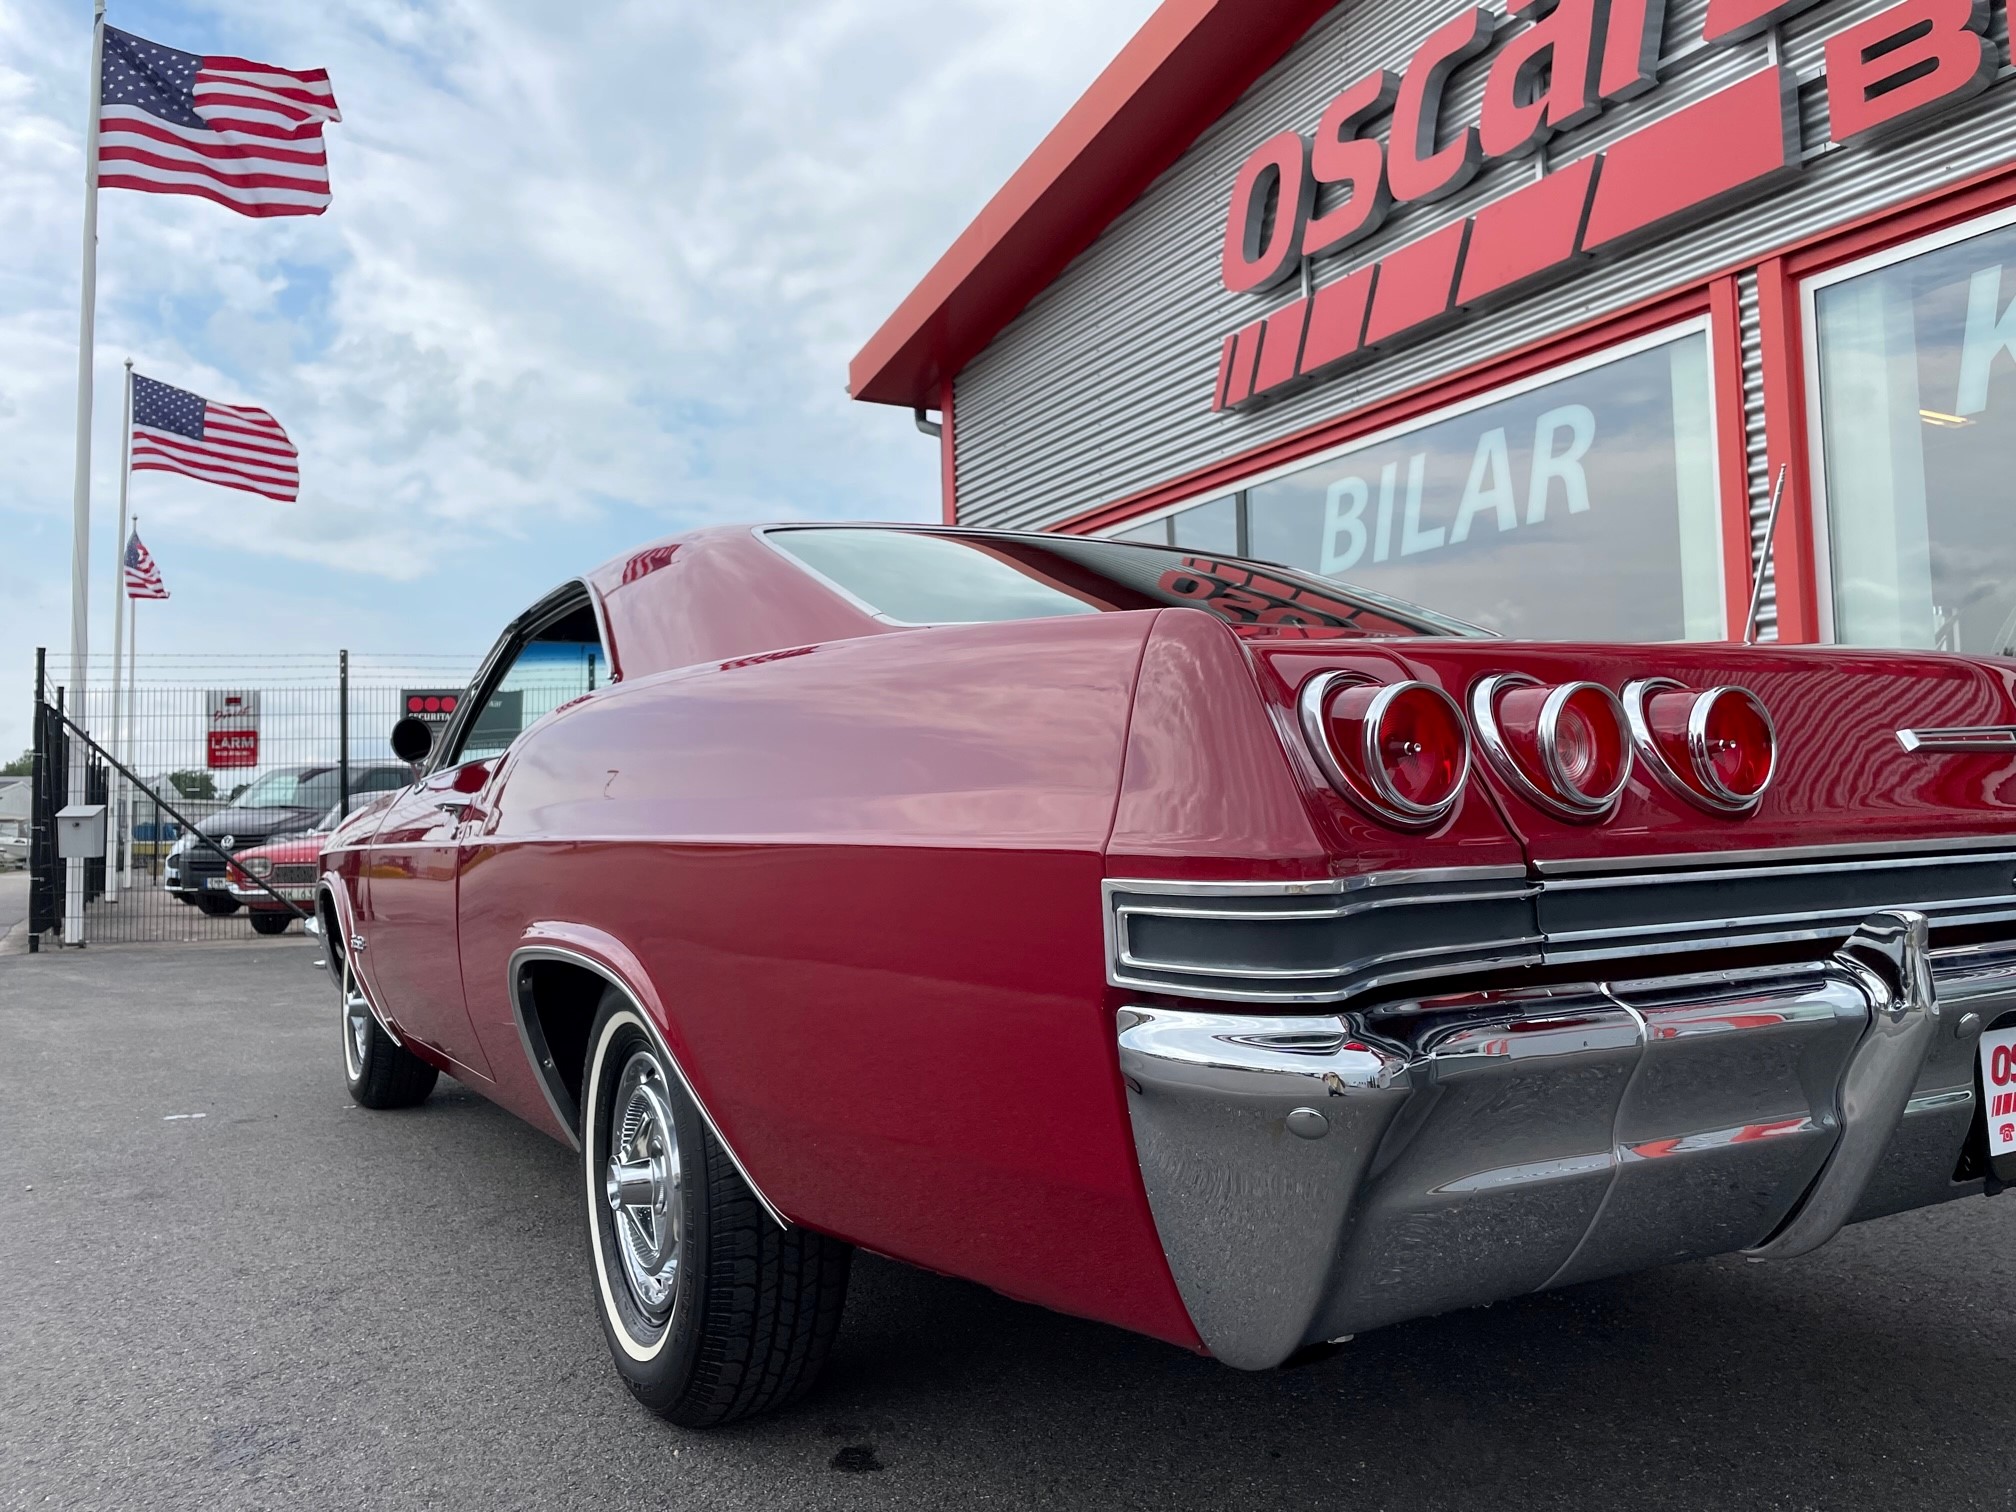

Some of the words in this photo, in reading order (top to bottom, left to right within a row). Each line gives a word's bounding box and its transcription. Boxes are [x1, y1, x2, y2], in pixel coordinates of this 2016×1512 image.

[1319, 404, 1596, 576] BILAR
[408, 712, 451, 721] SECURITA
[211, 736, 254, 749] LARM
